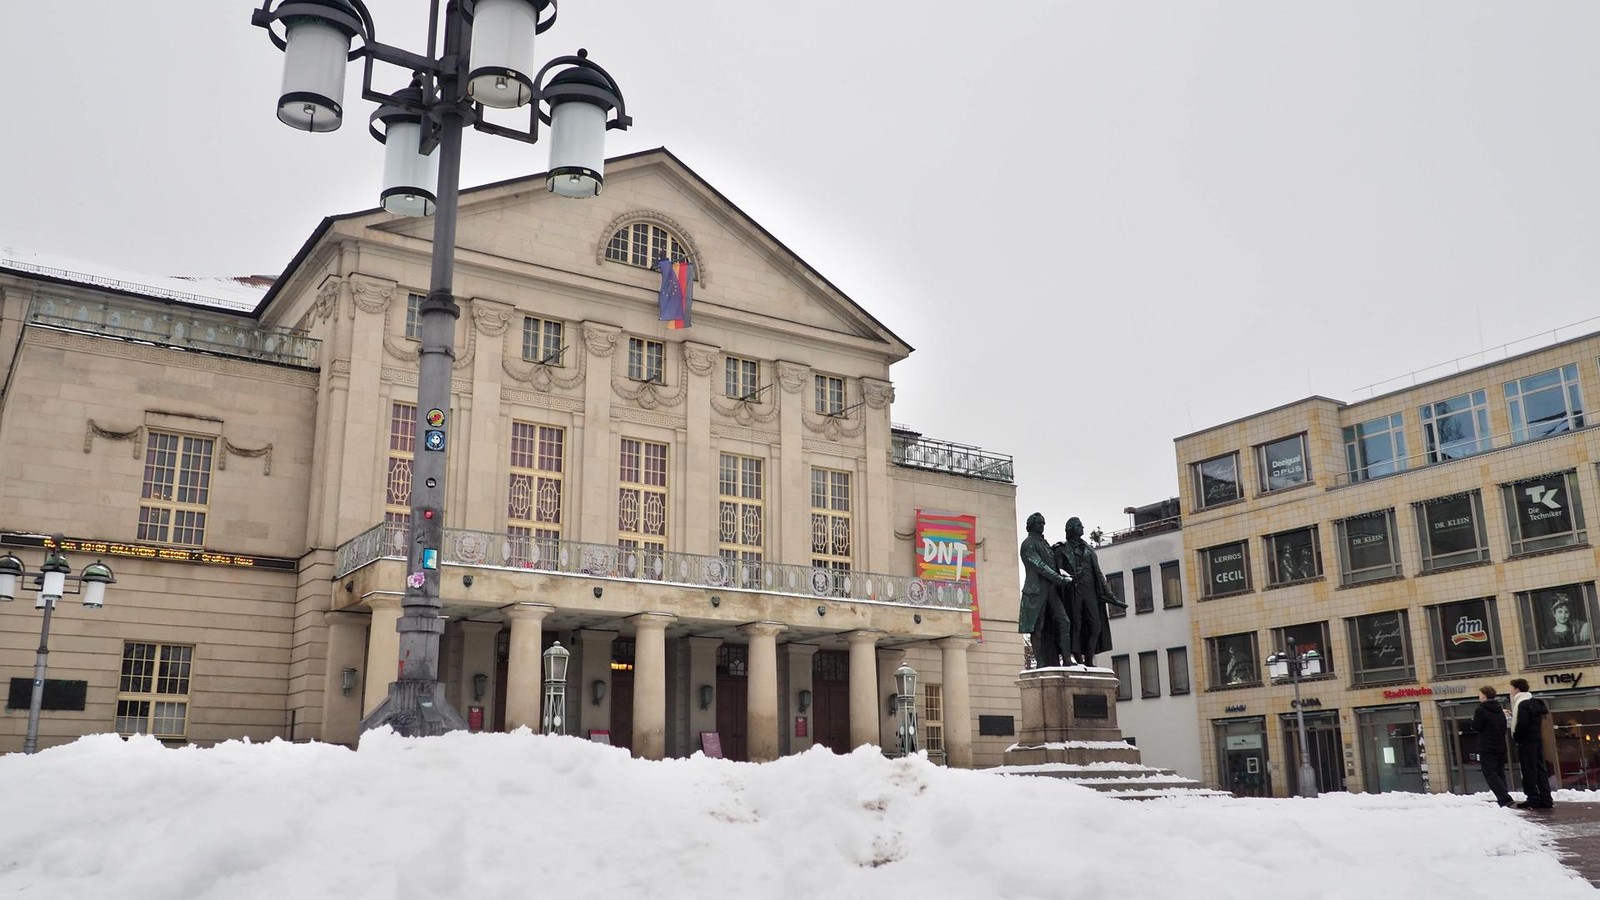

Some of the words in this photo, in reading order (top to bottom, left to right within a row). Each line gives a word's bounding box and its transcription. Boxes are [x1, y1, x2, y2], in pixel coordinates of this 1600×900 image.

[1273, 465, 1302, 477] OPUS
[1525, 485, 1562, 509] TK
[1528, 507, 1540, 515] Die
[1529, 510, 1562, 521] Techniker
[1447, 517, 1470, 527] KLEIN
[922, 537, 968, 582] DNT
[1214, 552, 1242, 563] LERROS
[1216, 569, 1244, 583] CECIL
[1457, 616, 1481, 634] dm
[1544, 672, 1583, 688] mey
